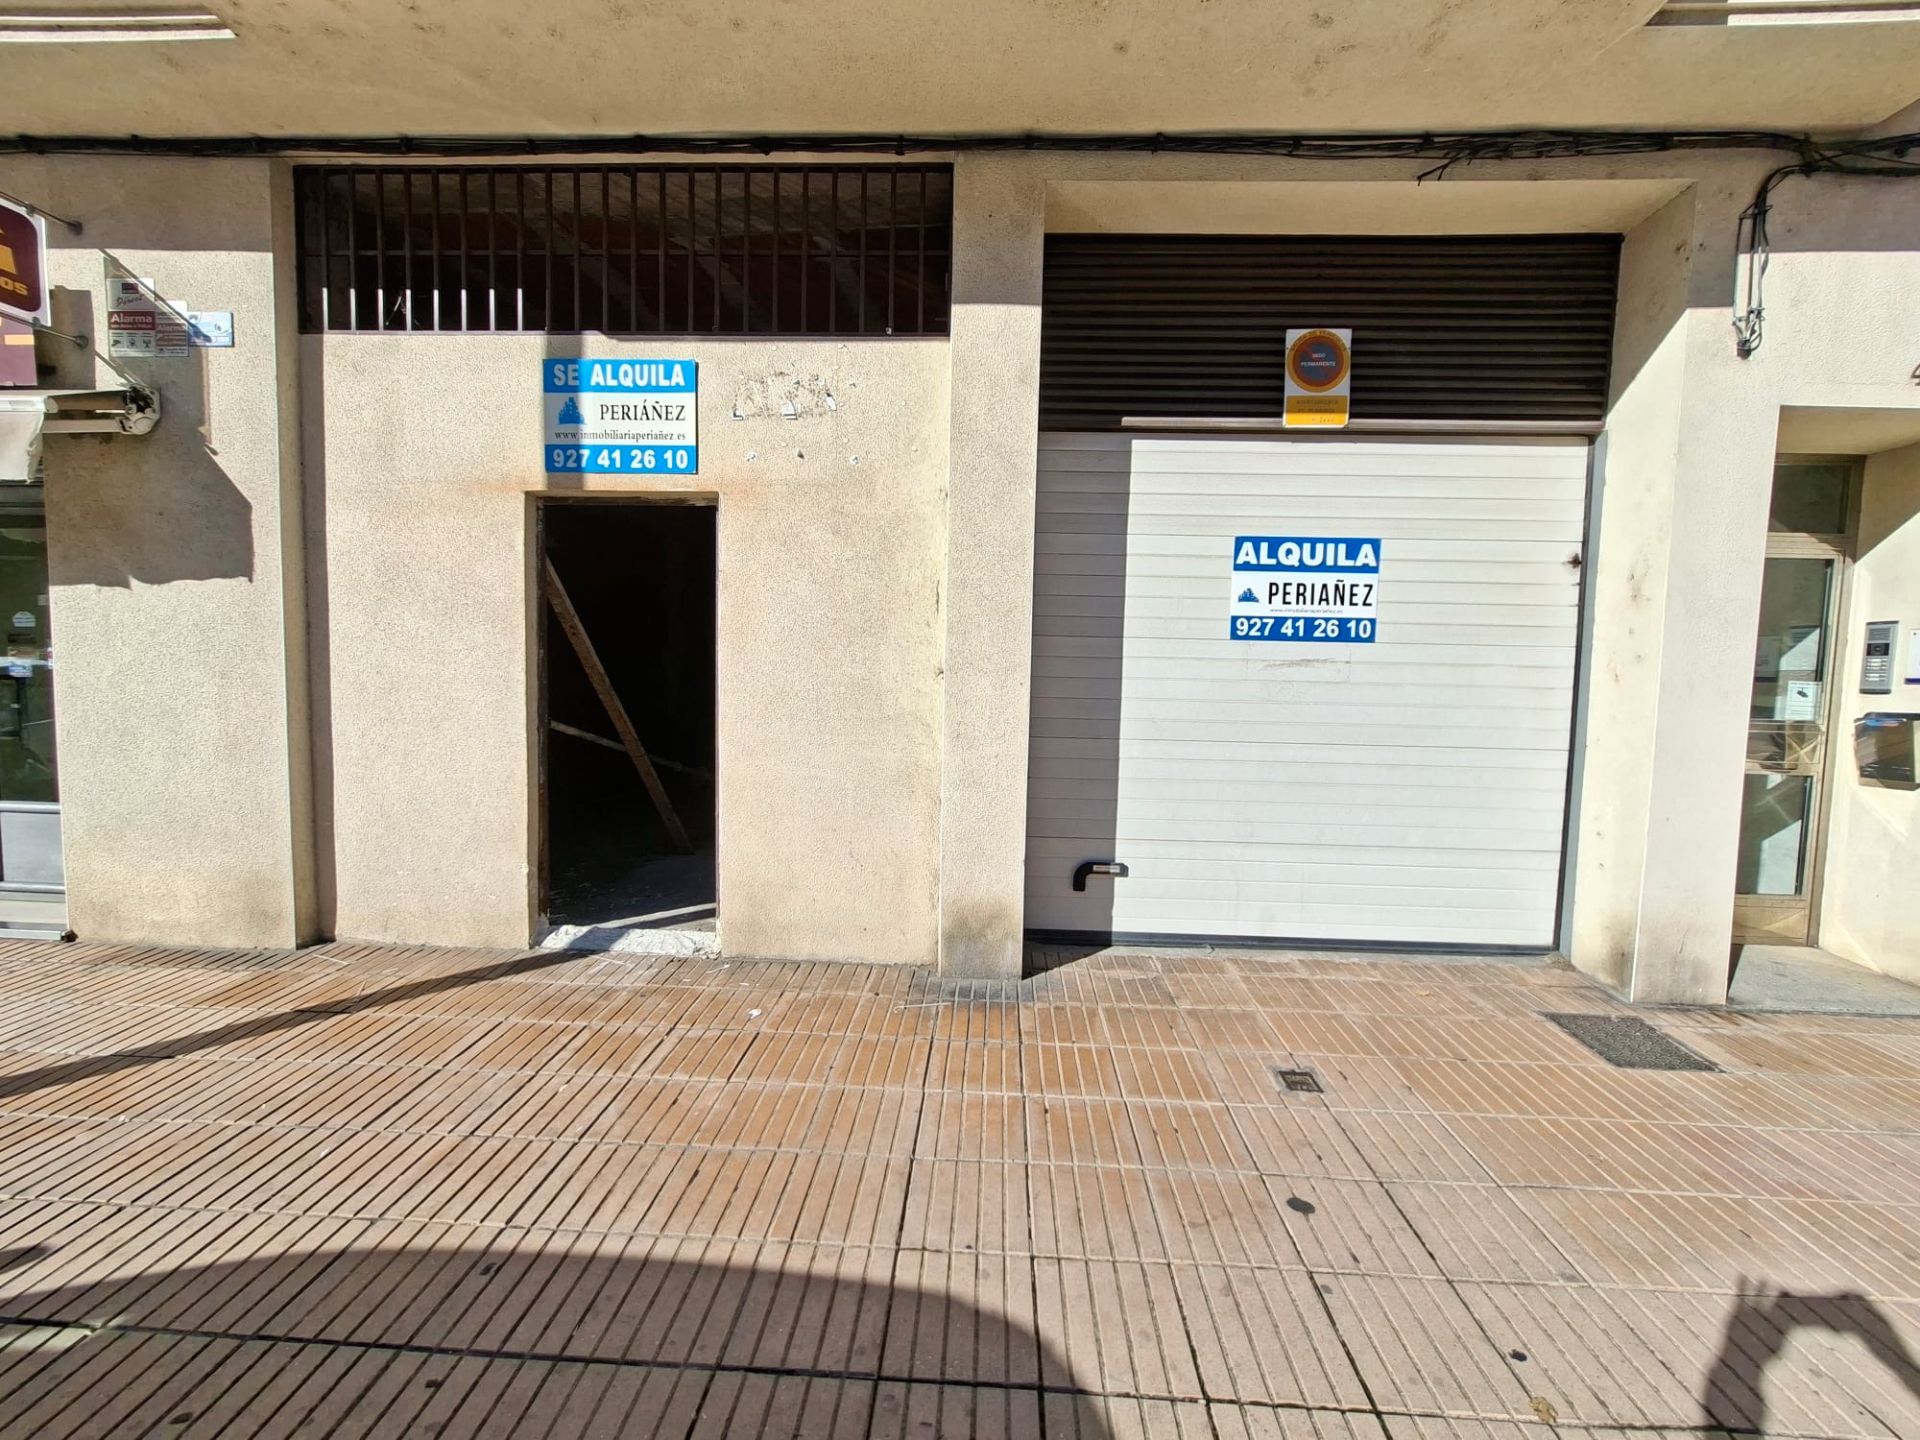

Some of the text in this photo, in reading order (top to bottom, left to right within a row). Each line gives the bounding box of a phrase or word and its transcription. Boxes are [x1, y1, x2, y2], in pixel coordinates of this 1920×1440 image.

[110, 312, 153, 323] Alarma
[553, 363, 686, 388] SE ALQUILA
[599, 399, 686, 422] PERIÁÑEZ
[553, 448, 689, 469] 927 41 26 10
[1236, 541, 1377, 567] ALQUILA
[1268, 579, 1374, 607] PERIAÑEZ
[1235, 617, 1372, 639] 927 41 26 10
